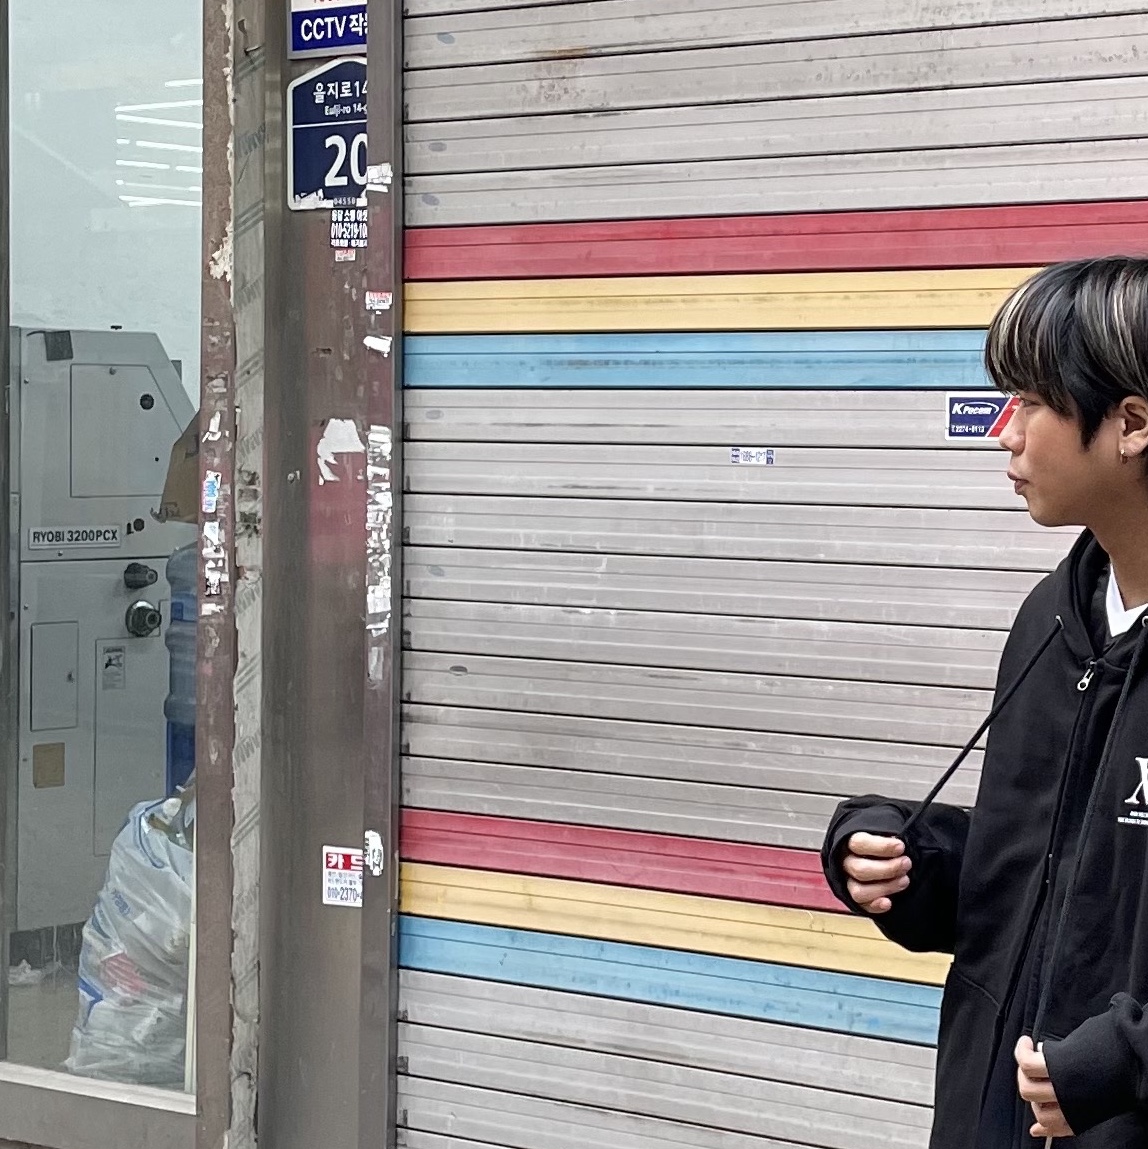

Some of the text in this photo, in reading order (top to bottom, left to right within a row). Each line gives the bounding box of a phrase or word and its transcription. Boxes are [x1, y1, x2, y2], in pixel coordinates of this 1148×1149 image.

[300, 12, 367, 42] CCTV 작
[324, 132, 368, 188] 20
[32, 529, 118, 543] RYOBI 3200PCX
